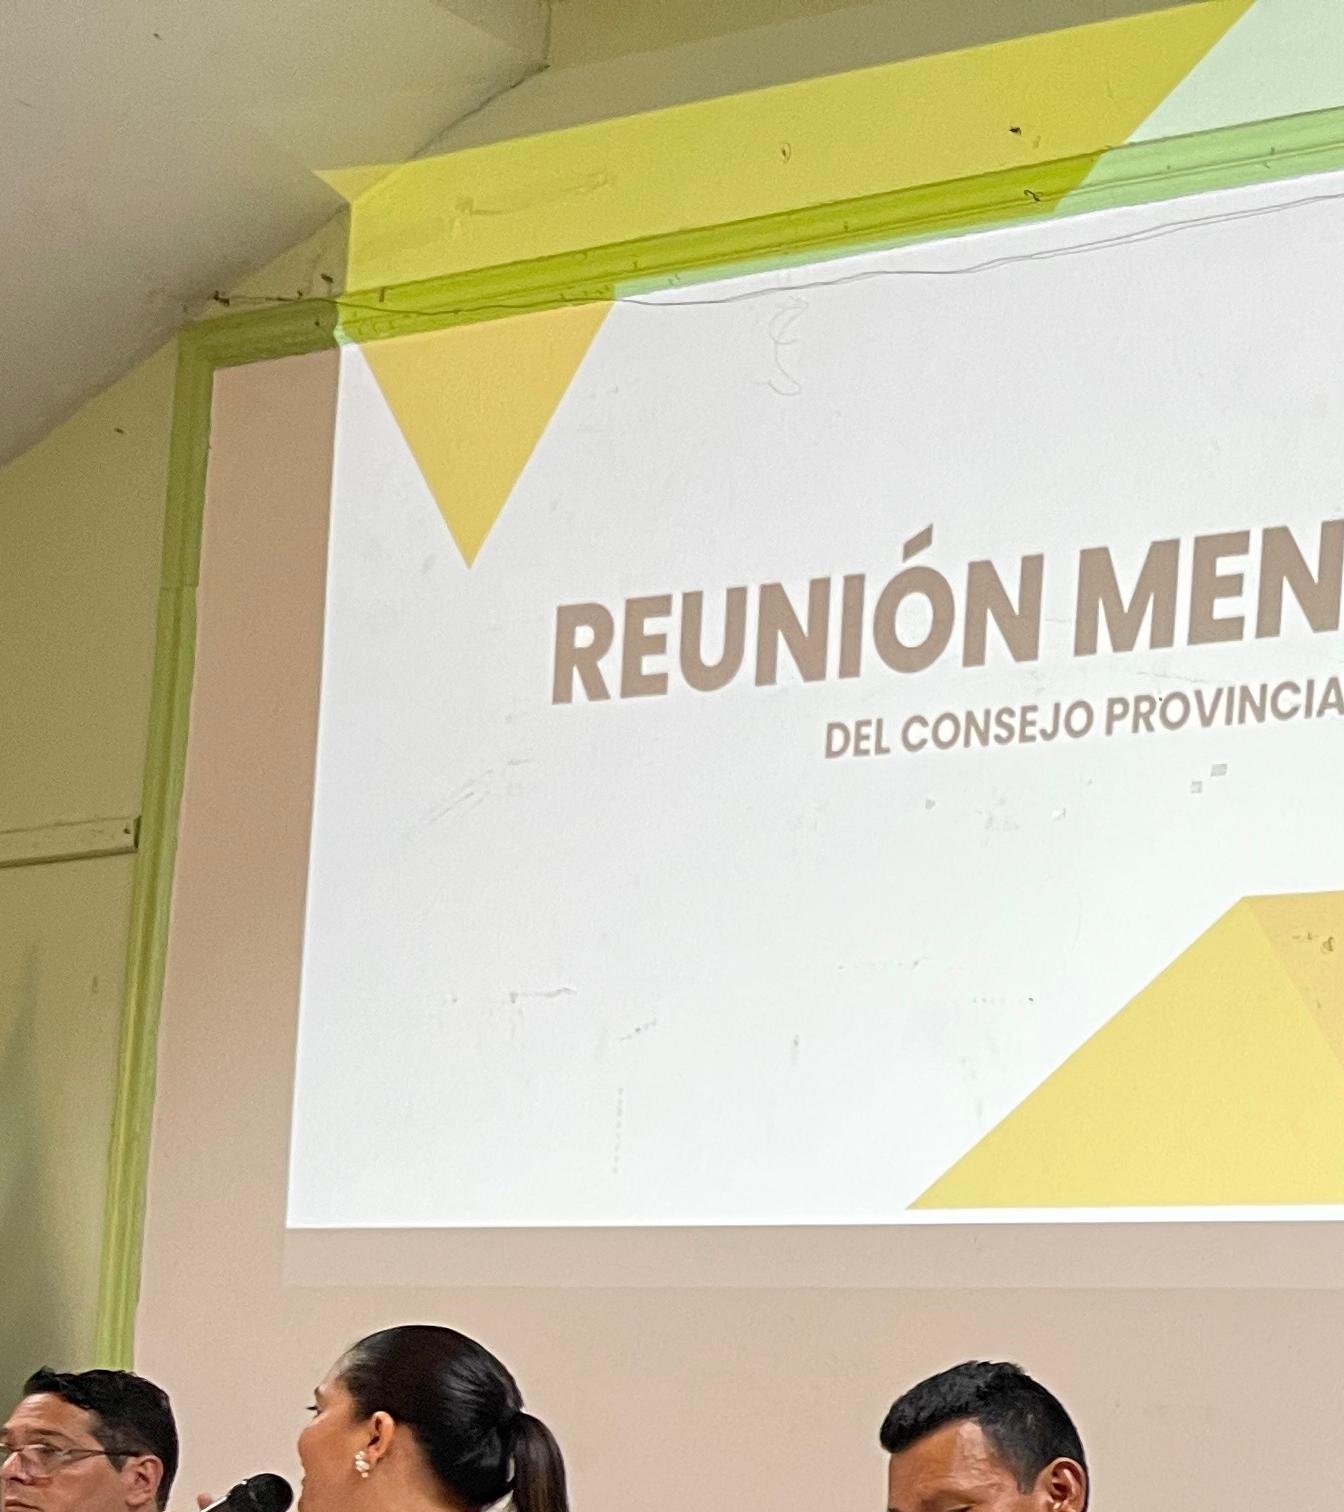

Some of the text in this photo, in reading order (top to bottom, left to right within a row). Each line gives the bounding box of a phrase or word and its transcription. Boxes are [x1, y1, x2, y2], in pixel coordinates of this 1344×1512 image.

[551, 523, 1045, 706] REUNIÓN
[825, 718, 891, 759] DEL
[901, 700, 1094, 752] CONSEJO
